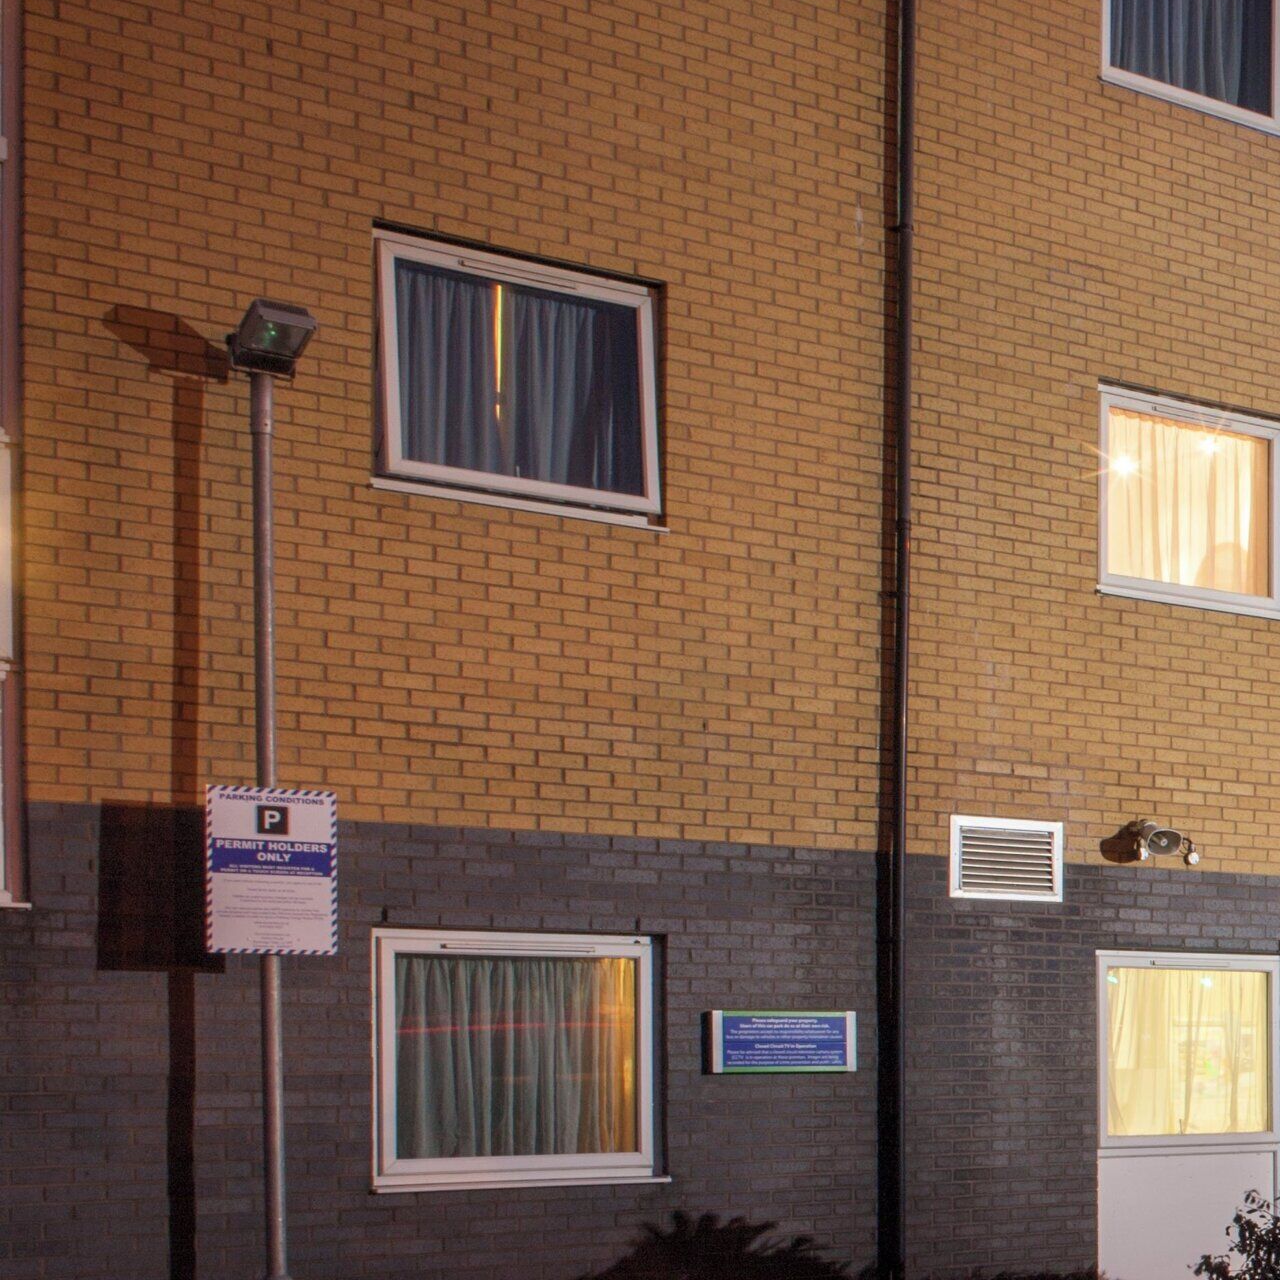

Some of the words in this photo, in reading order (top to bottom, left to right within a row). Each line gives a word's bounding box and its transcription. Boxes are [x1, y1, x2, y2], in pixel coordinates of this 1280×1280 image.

[219, 793, 263, 802] PARKING
[265, 796, 325, 806] CONDITIONS
[264, 810, 281, 830] P
[216, 839, 265, 850] PERMIT
[268, 842, 328, 852] HOLDERS
[257, 852, 292, 862] ONLY
